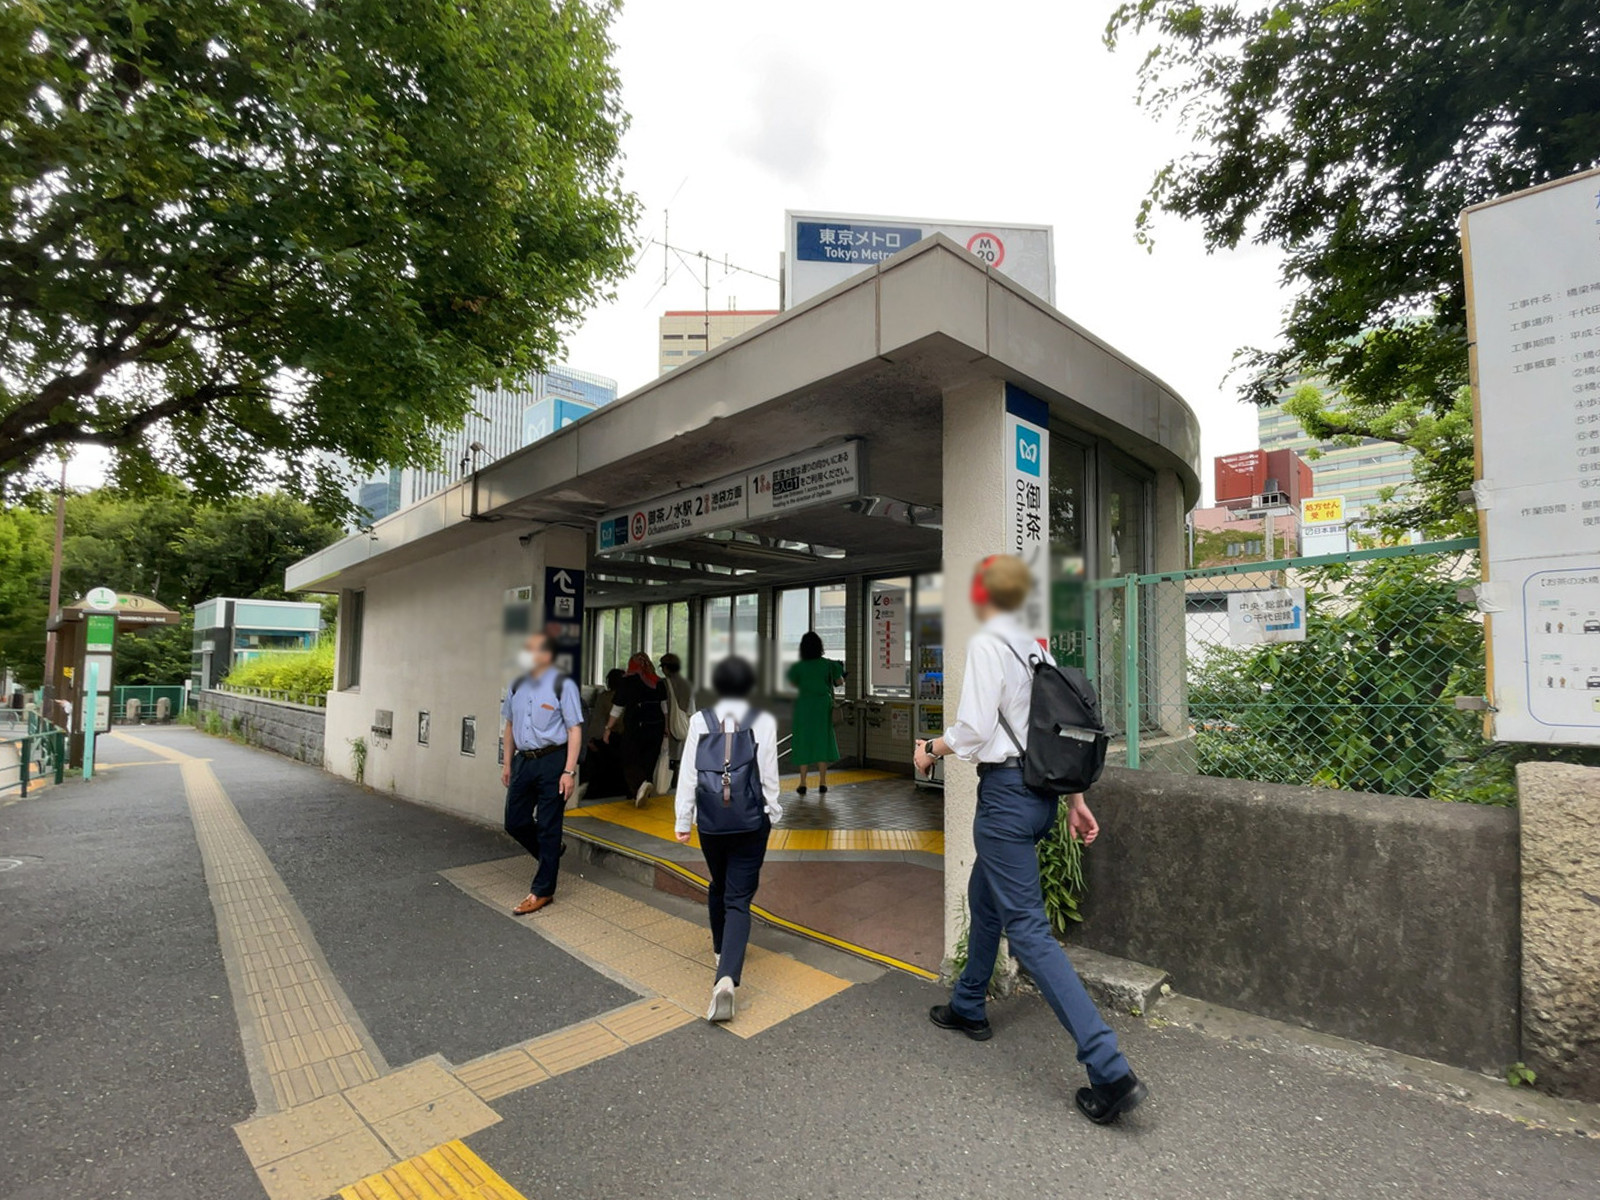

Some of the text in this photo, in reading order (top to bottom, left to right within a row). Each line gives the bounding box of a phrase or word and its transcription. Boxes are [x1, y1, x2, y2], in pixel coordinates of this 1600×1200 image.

[819, 229, 900, 247] 東京メトロ
[980, 239, 991, 249] M
[824, 247, 858, 260] Tokyo
[977, 251, 995, 263] 20
[753, 477, 758, 494] 1
[711, 485, 742, 504] 池袋方面
[648, 500, 692, 525] 御茶ノ水駅
[695, 496, 703, 516] 2
[1305, 501, 1339, 511] 処方せん
[1016, 479, 1026, 551] Ochano
[1239, 599, 1293, 611] 中央・総武線
[875, 609, 881, 619] 2
[1253, 611, 1293, 623] 千代田線
